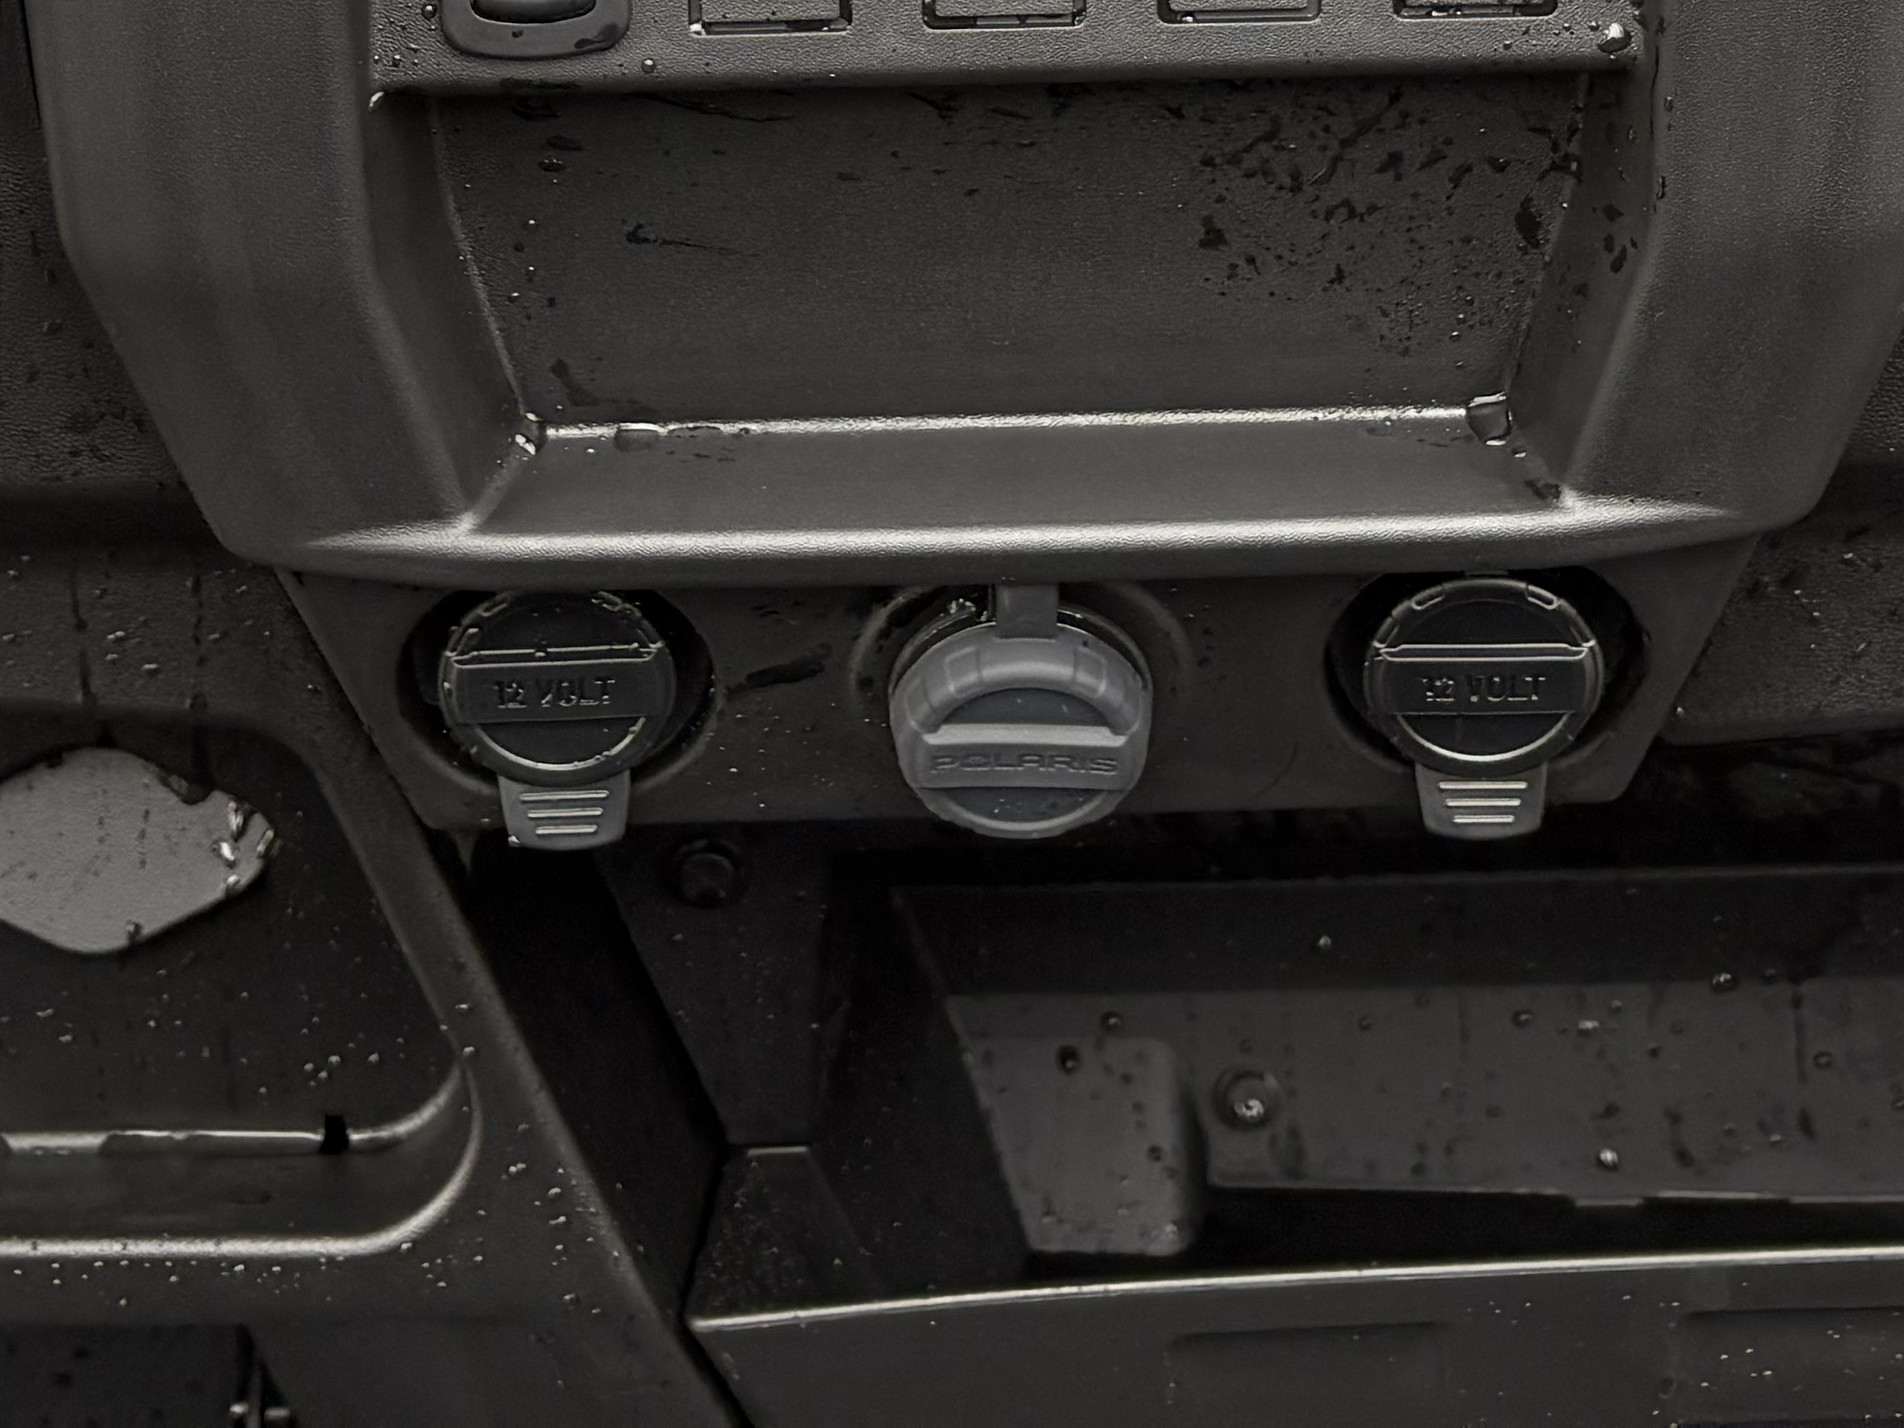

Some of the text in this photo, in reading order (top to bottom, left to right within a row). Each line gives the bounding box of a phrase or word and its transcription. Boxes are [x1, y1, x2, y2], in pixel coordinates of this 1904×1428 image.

[537, 677, 616, 708] VOLT
[1463, 674, 1547, 703] VOLT
[928, 753, 1120, 776] POLARIS
